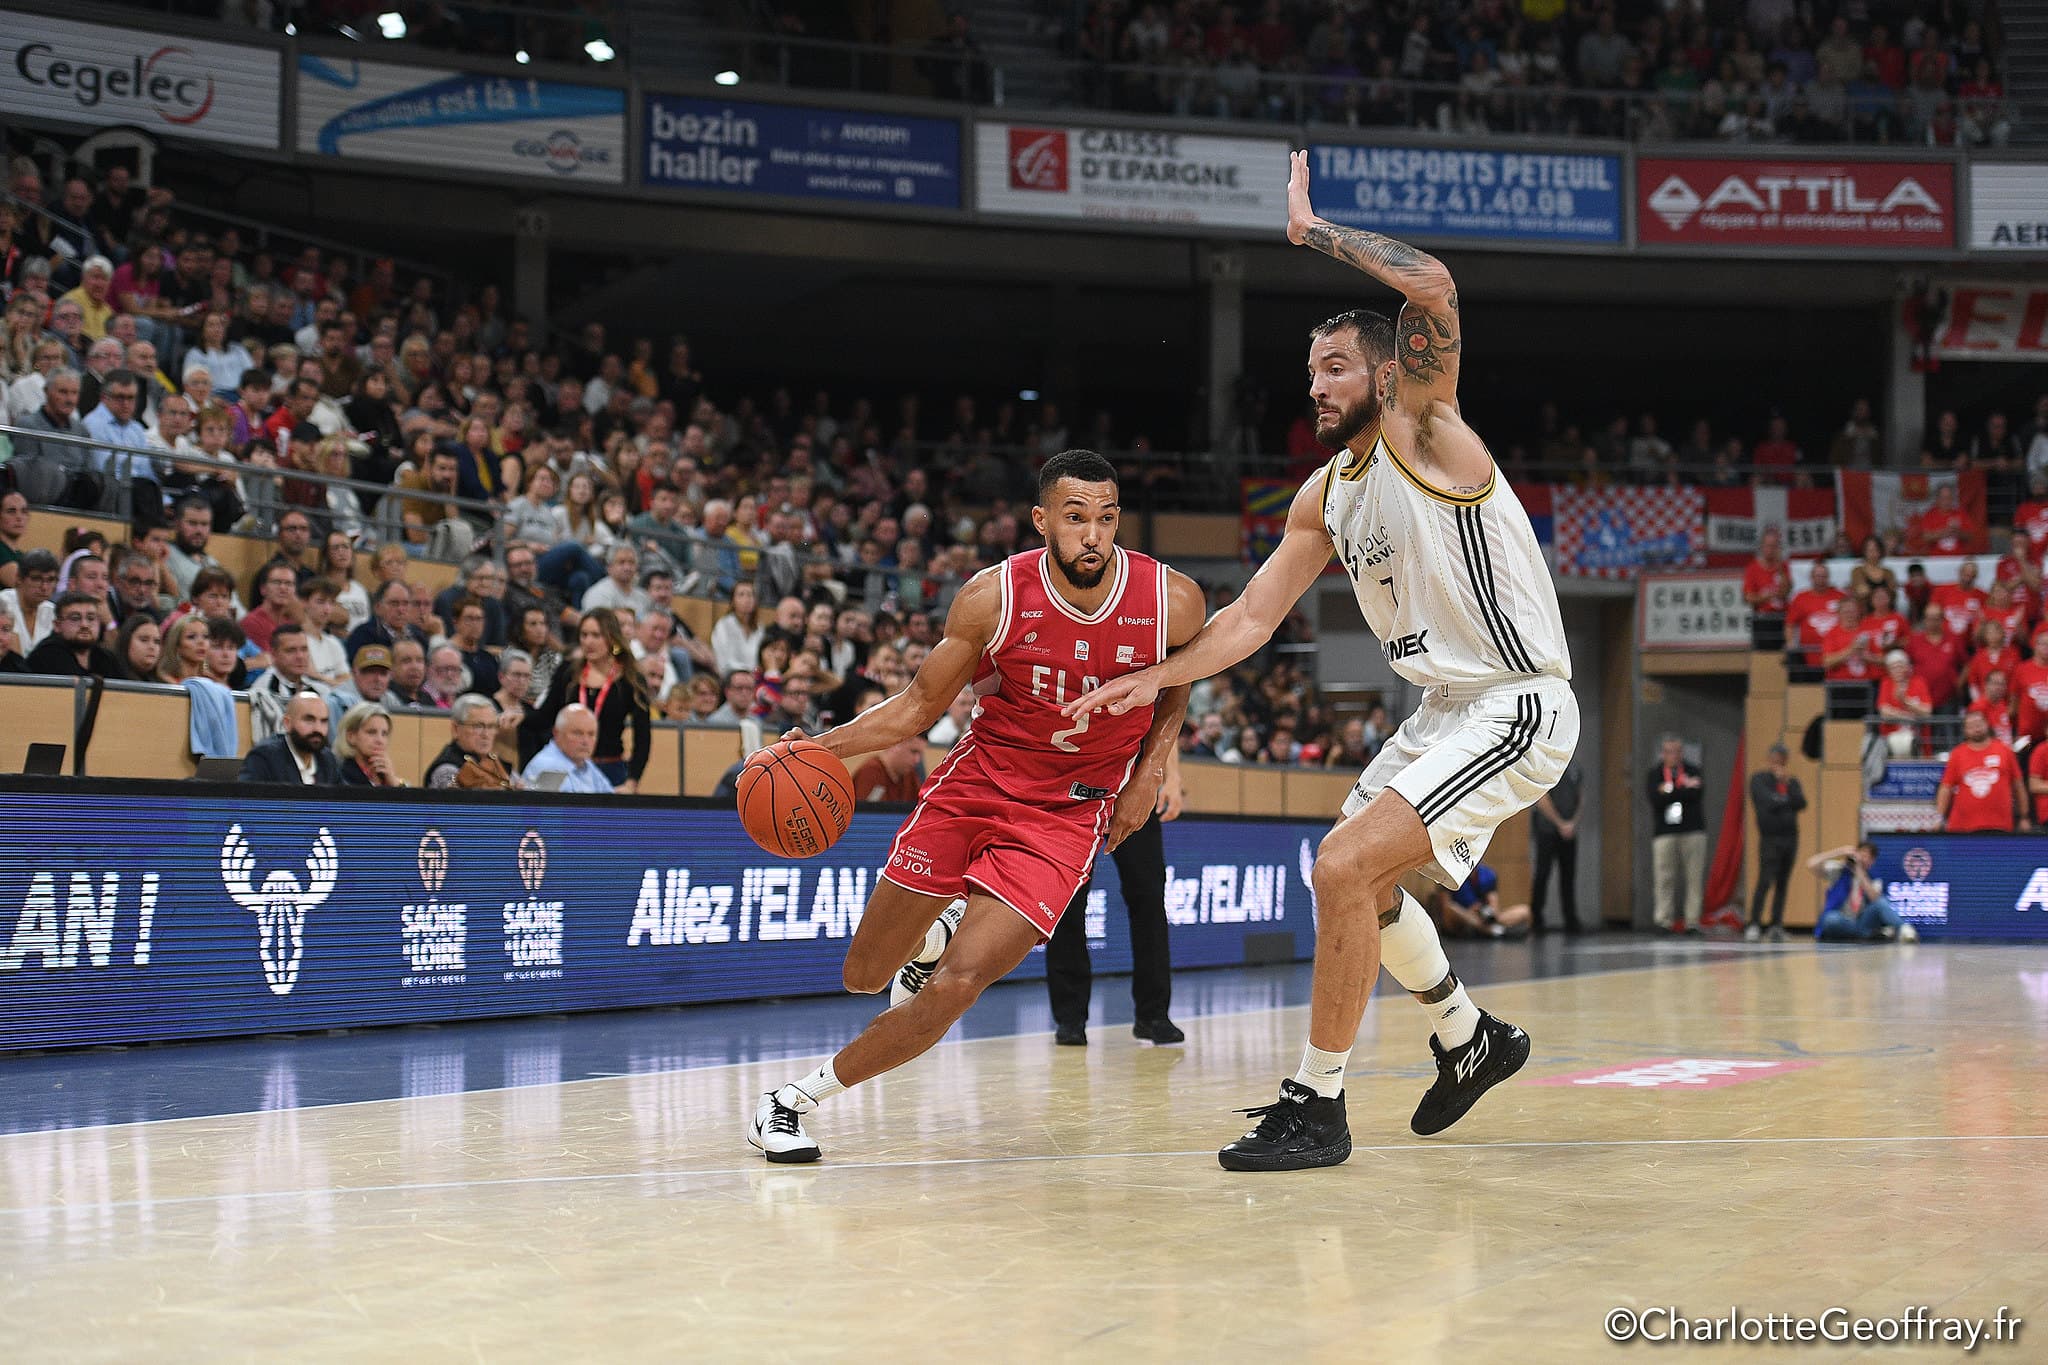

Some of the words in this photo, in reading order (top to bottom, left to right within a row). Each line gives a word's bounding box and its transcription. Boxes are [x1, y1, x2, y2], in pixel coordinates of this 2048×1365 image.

[16, 43, 198, 106] Cegelec
[652, 103, 758, 151] bezin
[1080, 127, 1177, 159] CAISSE
[650, 142, 760, 185] haller
[1081, 157, 1240, 189] D'EPARGNE
[1314, 146, 1495, 187] TRANSPORTS
[1502, 155, 1613, 192] PETEUIL
[1354, 182, 1577, 218] 06.22.41.40.08
[1702, 176, 1942, 214] ATTILA
[1761, 213, 1778, 228] et
[1379, 575, 1399, 610] 7
[1653, 585, 1738, 610] CHALO
[1127, 617, 1155, 627] PAPREC
[1383, 629, 1429, 662] NEK
[903, 860, 932, 877] JOA
[907, 846, 928, 857] CASINO
[134, 872, 161, 965] !
[627, 869, 734, 946] Allez
[738, 867, 868, 941] l'ELAN
